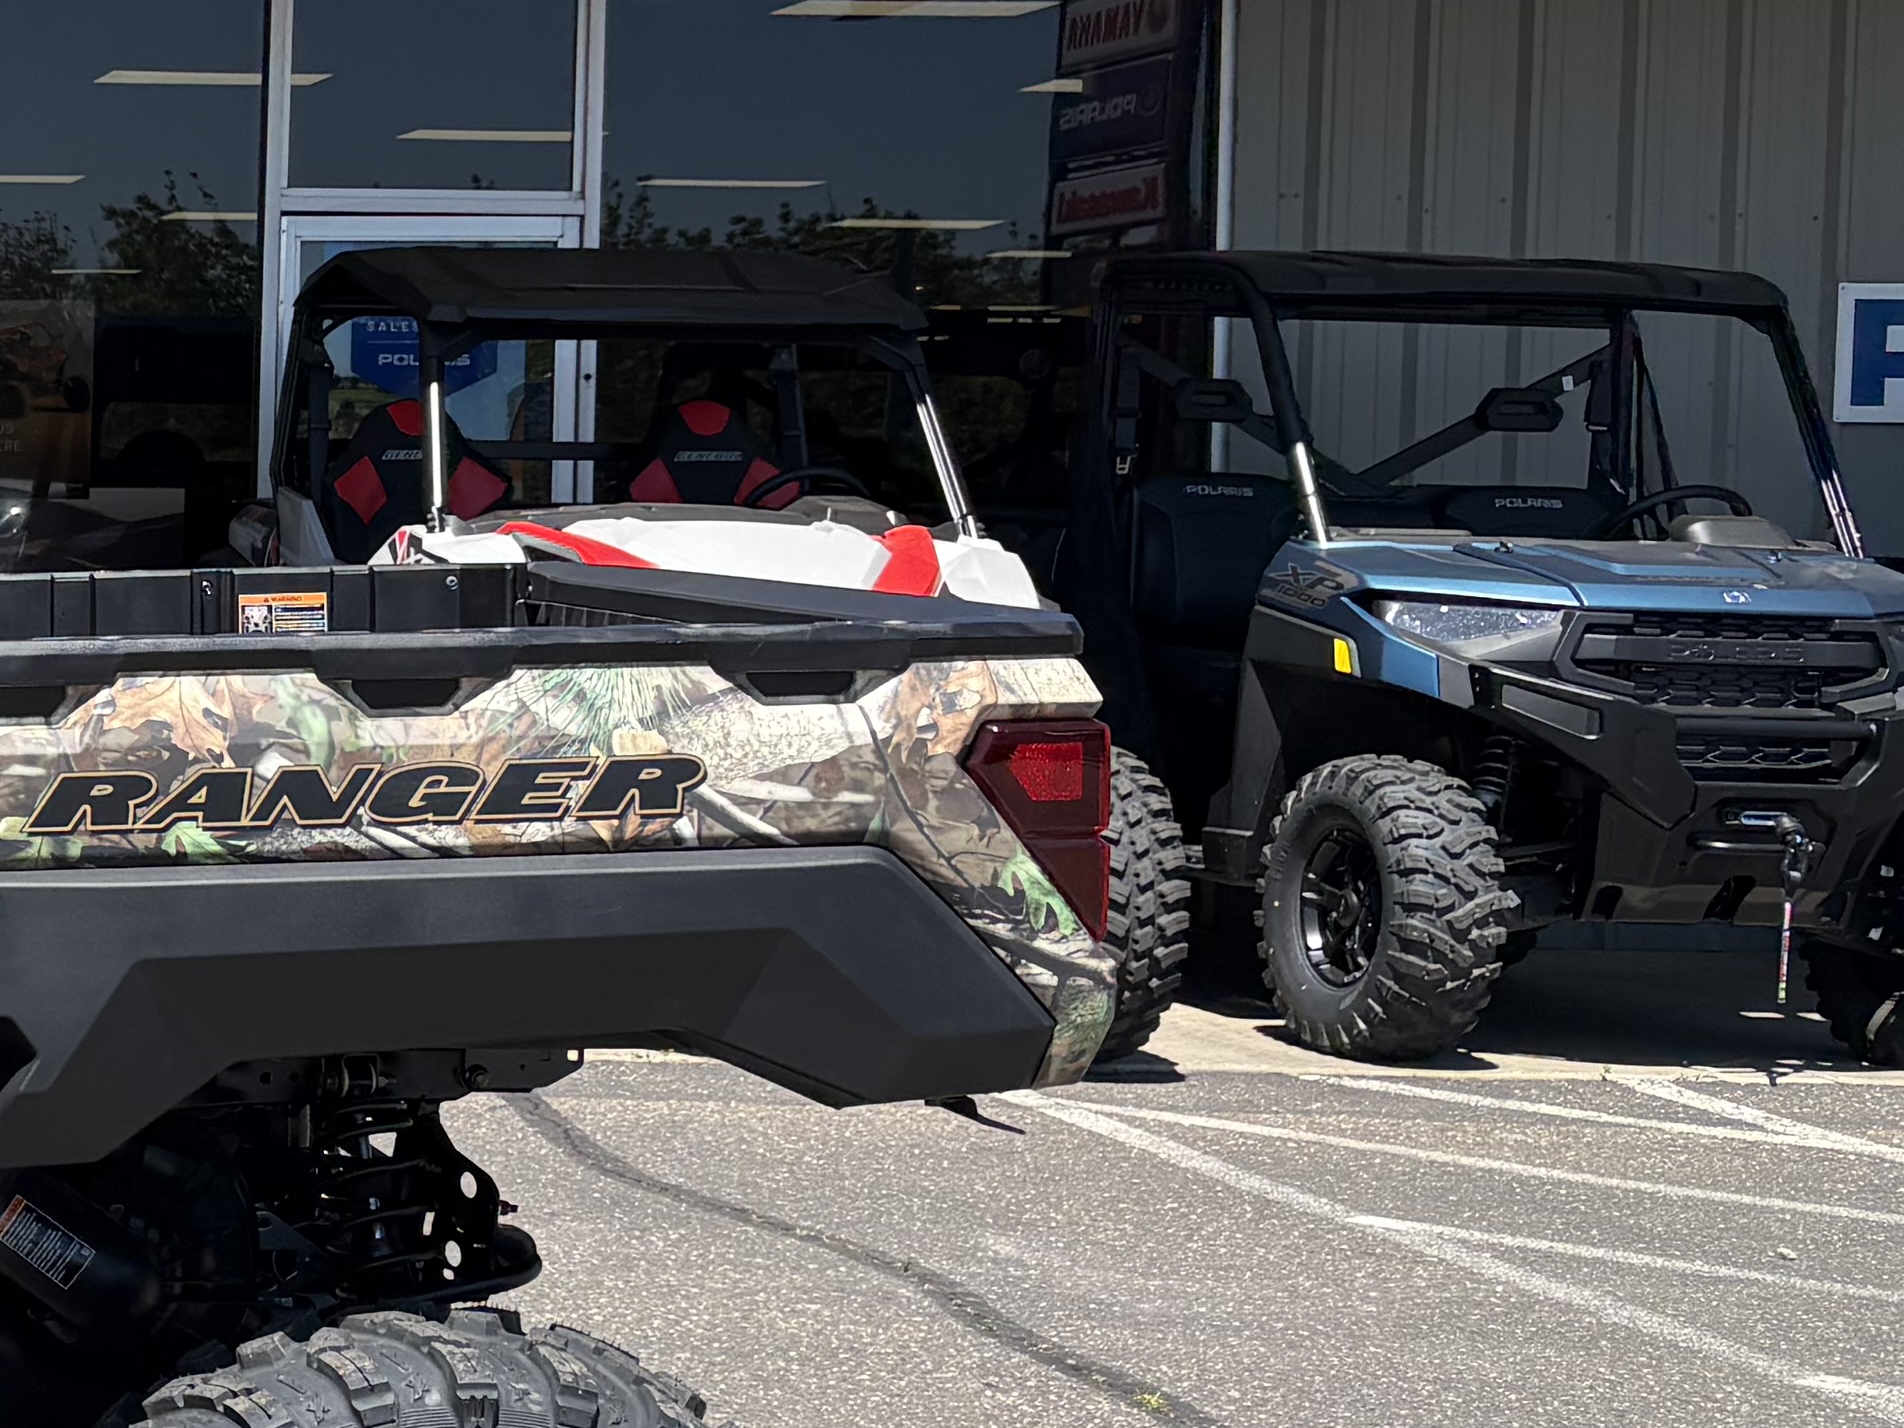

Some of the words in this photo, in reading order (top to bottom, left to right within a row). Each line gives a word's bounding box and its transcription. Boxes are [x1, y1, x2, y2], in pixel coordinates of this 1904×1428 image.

[378, 353, 471, 366] POLS
[1183, 484, 1254, 497] POLARIS
[1494, 498, 1563, 509] POLARIS
[1268, 562, 1345, 592] XP
[1277, 583, 1326, 609] 1000
[22, 754, 708, 835] RANGER
